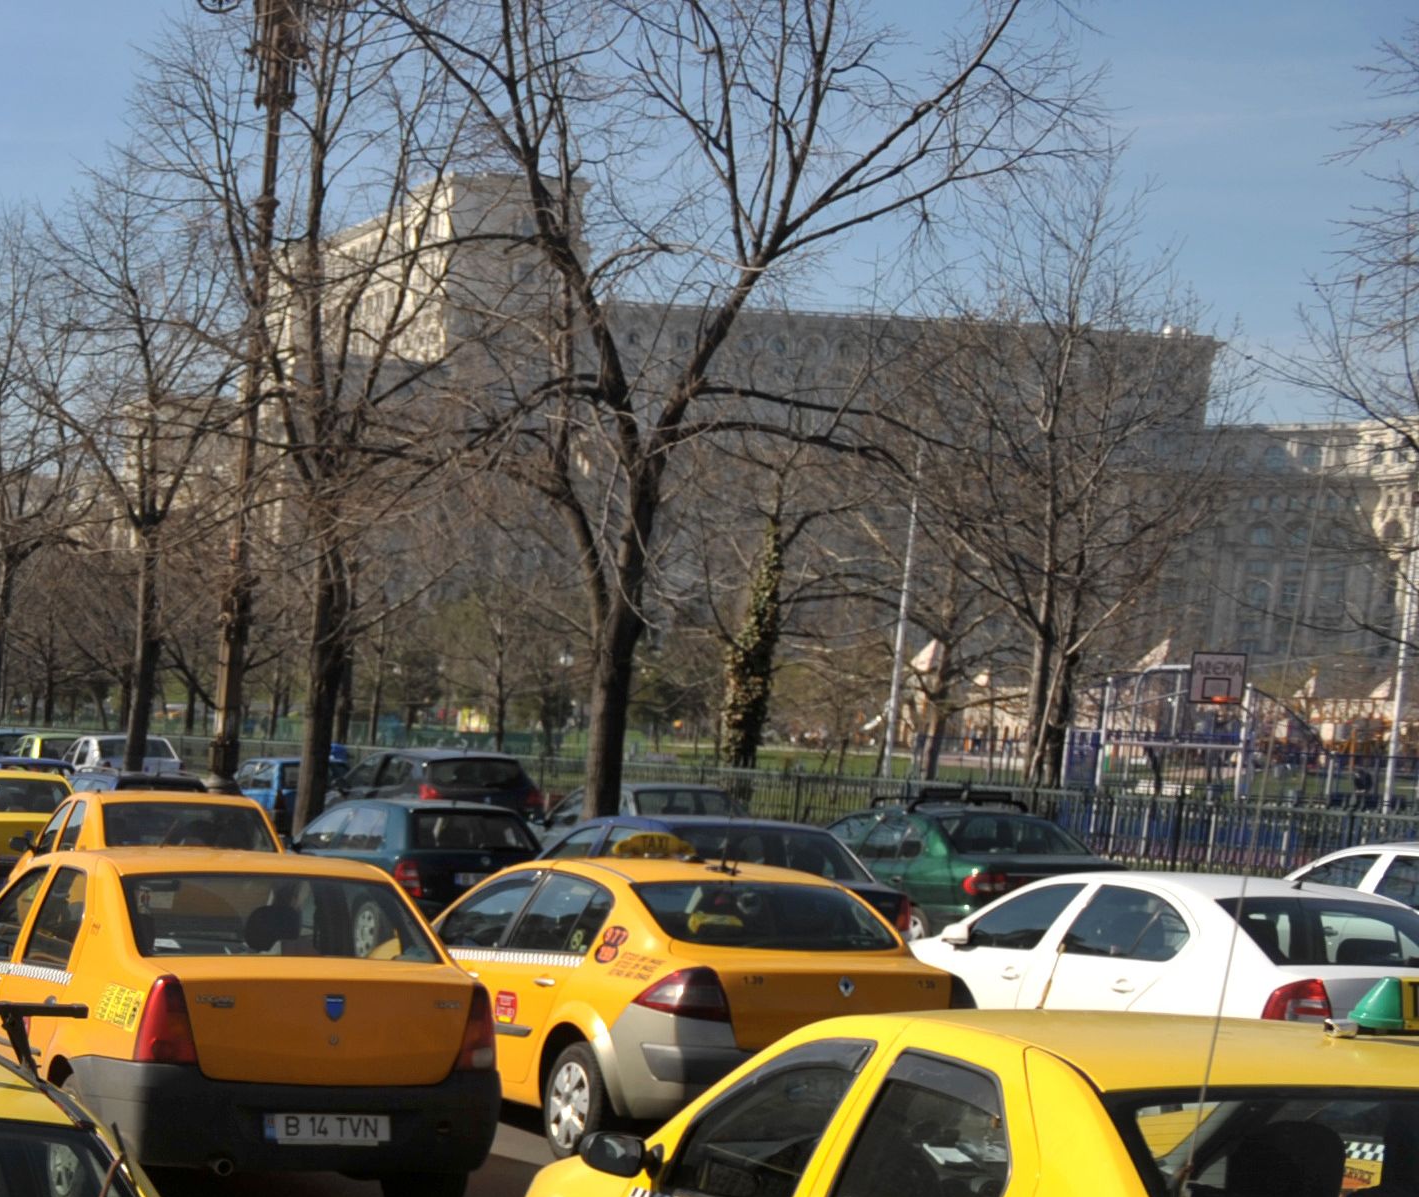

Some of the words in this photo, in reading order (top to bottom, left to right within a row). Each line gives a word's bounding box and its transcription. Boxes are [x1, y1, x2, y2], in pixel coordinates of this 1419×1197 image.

[285, 1115, 301, 1137] B
[308, 1115, 330, 1137] 14
[338, 1116, 380, 1139] TVN
